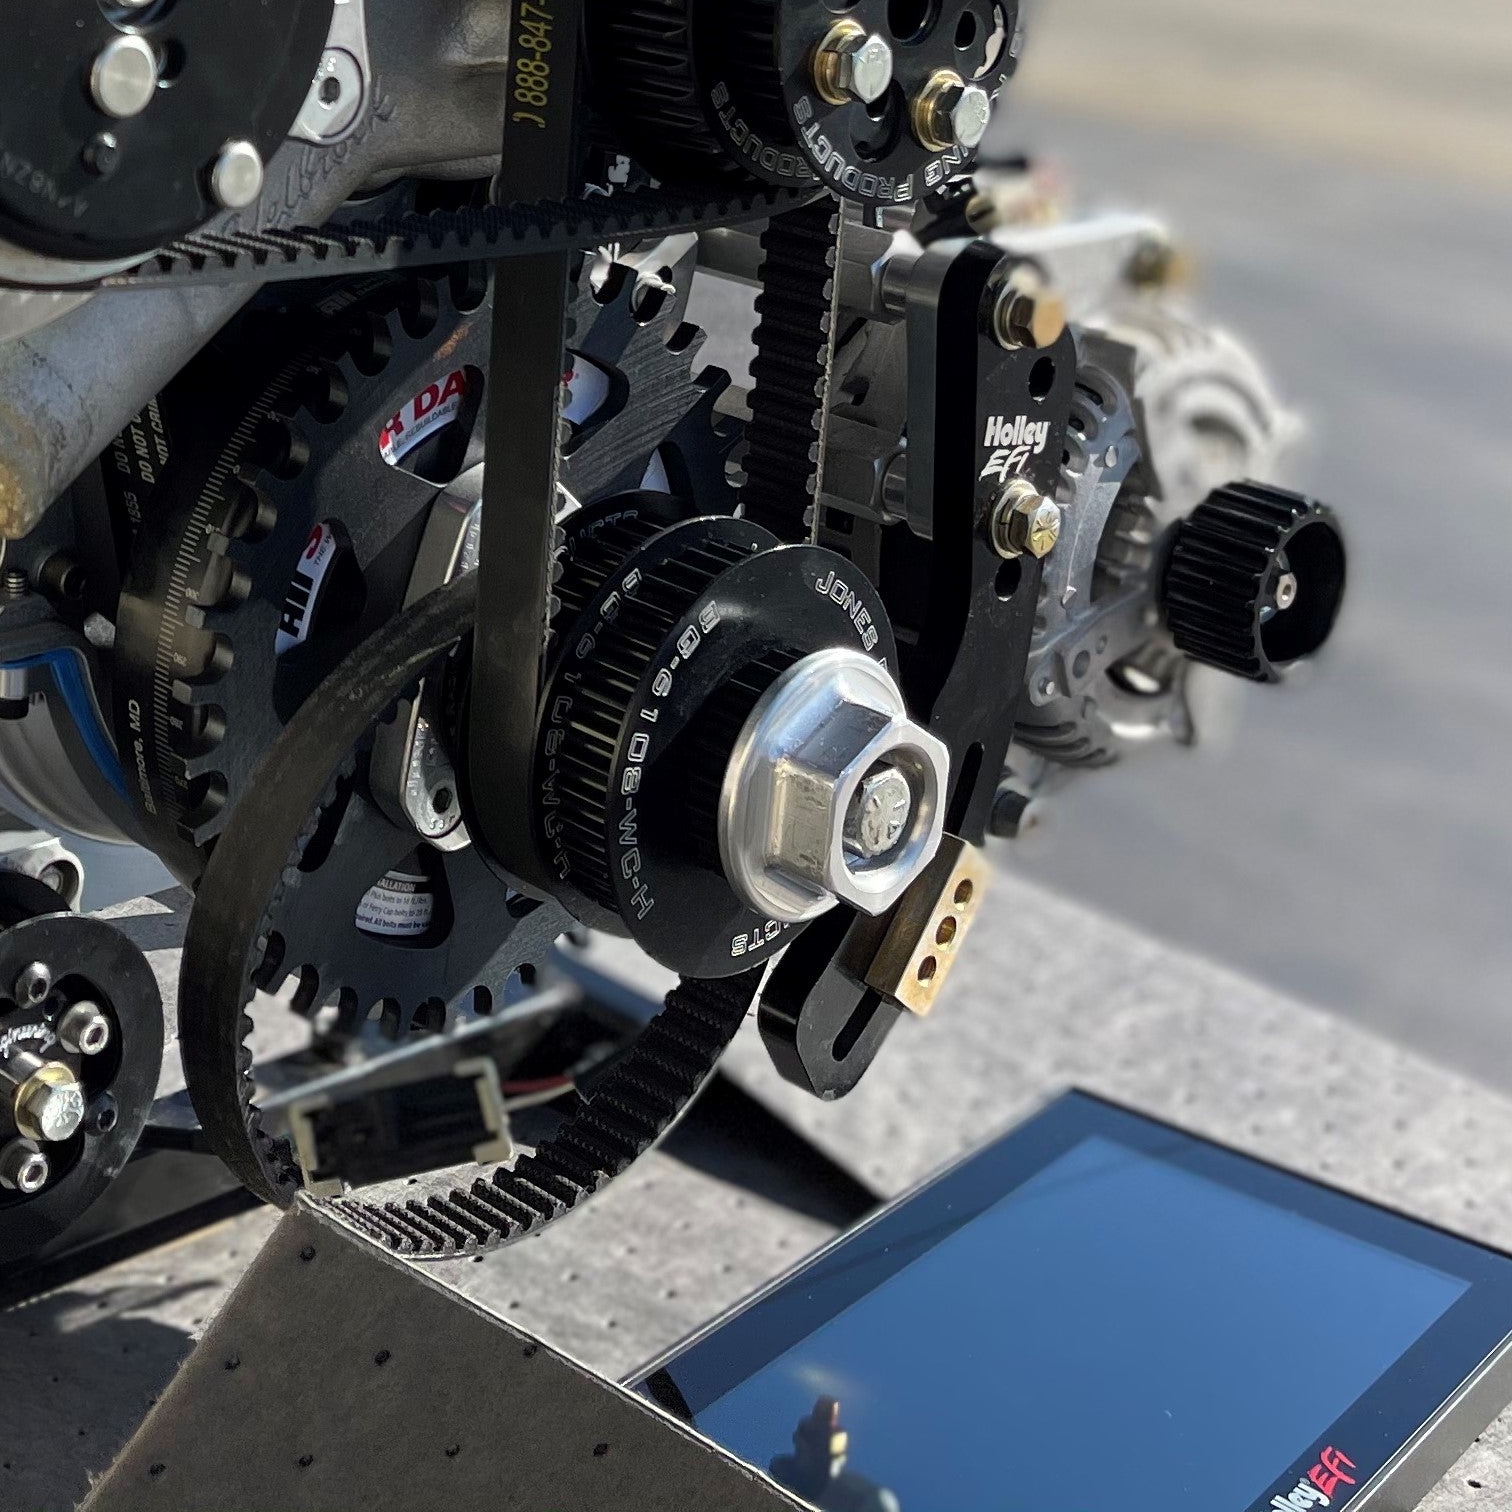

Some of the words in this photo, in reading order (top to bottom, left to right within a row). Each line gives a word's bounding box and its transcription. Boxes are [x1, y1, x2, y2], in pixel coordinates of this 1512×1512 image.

[710, 81, 820, 181] RODUCTS
[793, 94, 914, 203] PRODUCTS
[984, 415, 1049, 455] Holley
[814, 570, 879, 652] JONES
[128, 698, 142, 734] MD
